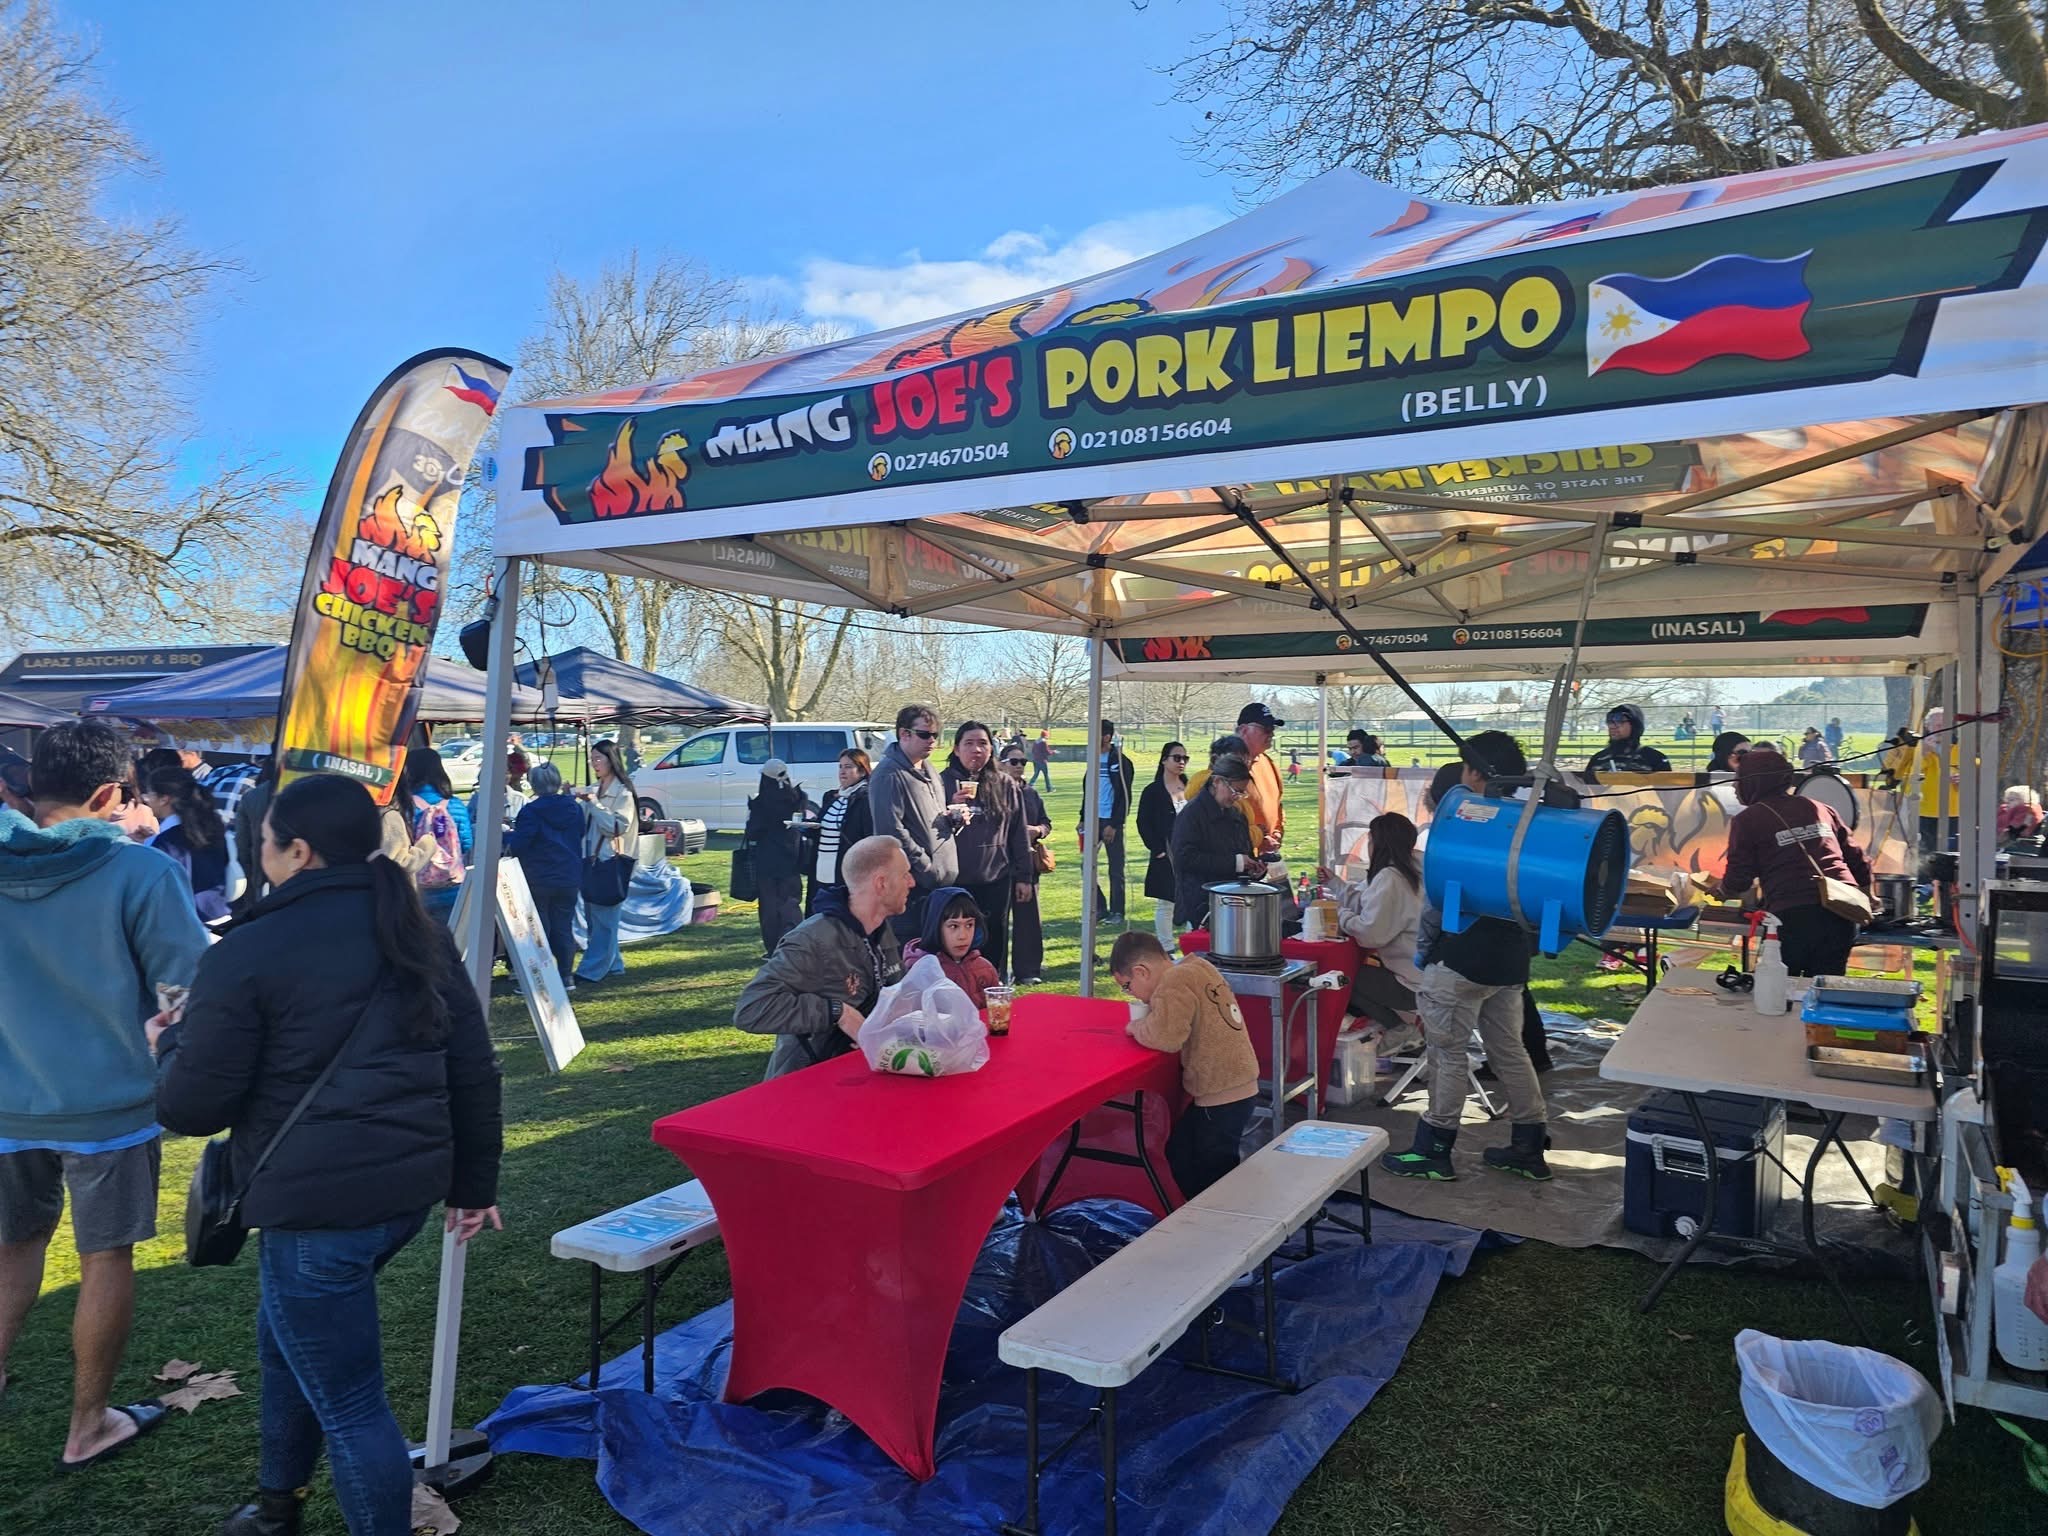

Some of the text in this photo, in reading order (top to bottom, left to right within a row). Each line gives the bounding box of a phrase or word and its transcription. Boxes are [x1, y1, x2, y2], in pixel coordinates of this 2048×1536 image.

[706, 276, 1562, 458] MANG JOE'S PORK LIEMPO
[1401, 375, 1547, 423] (BELLY)
[1080, 417, 1232, 449] 02108156604
[894, 441, 1009, 472] 0274670504
[352, 538, 438, 591] MANG
[321, 557, 438, 623] JOE'S
[315, 592, 429, 646] CHICKEN
[1472, 627, 1563, 641] 02108156604
[1651, 619, 1745, 639] (INASAL)
[24, 653, 203, 668] LAPAZ BATCHOY & BBQ
[342, 623, 397, 661] BBQ
